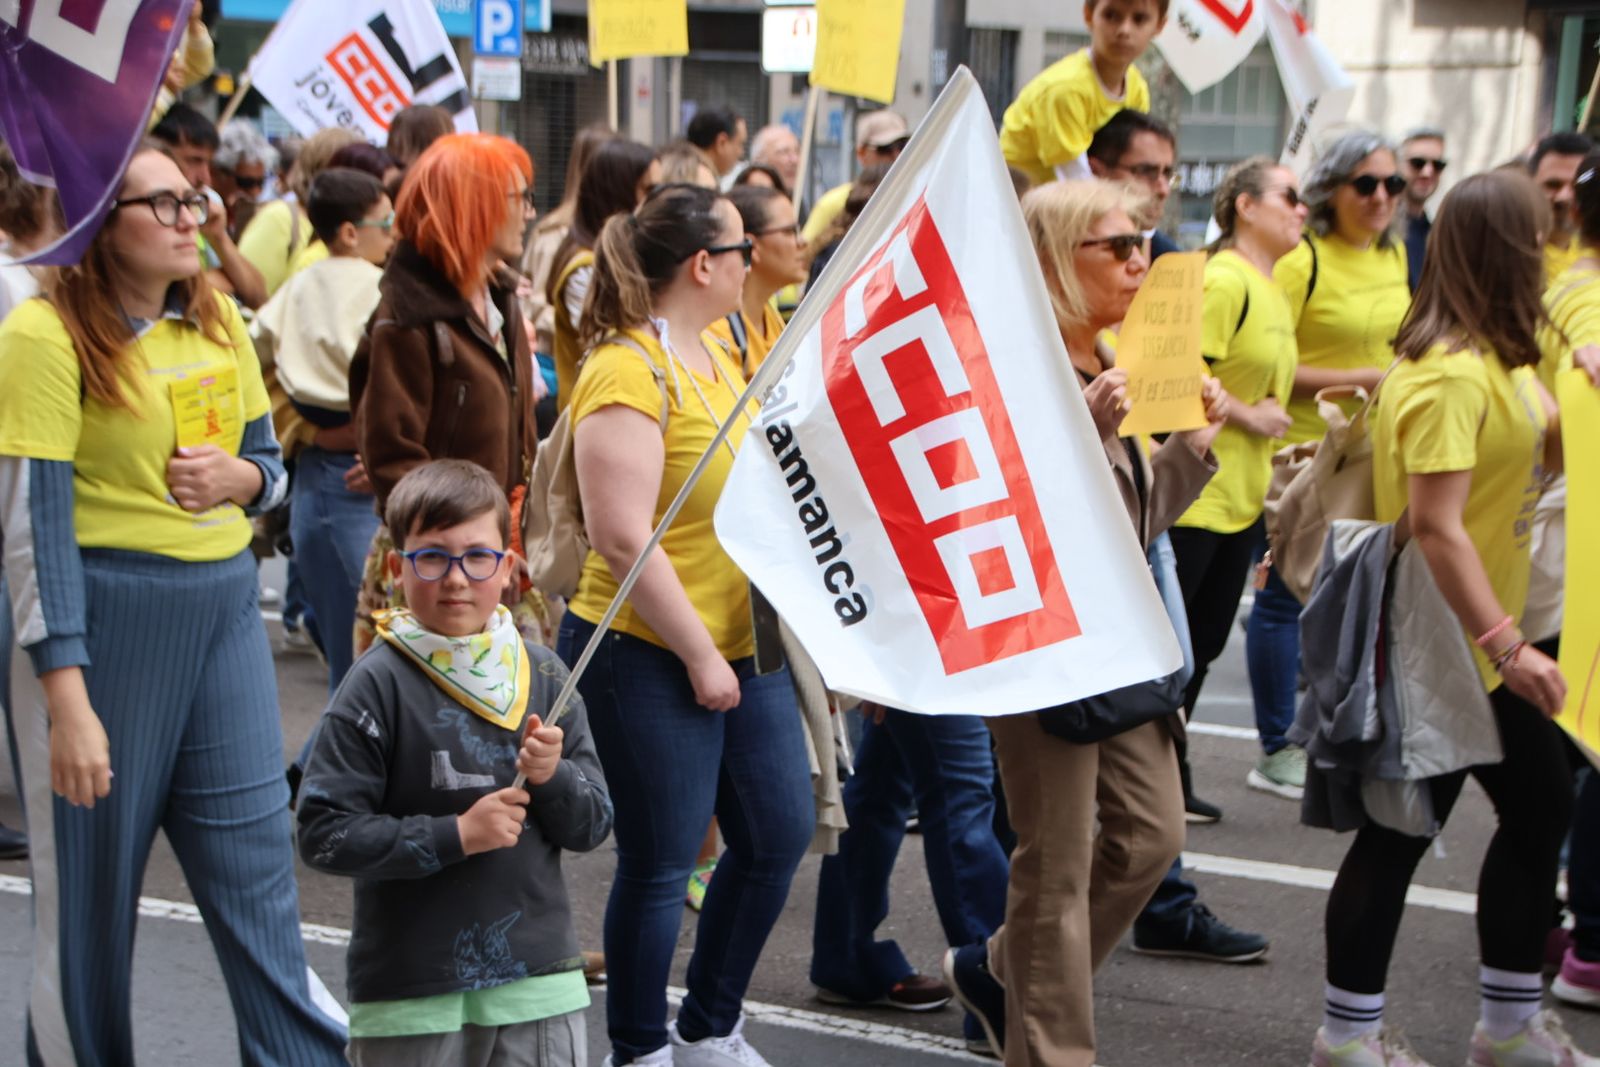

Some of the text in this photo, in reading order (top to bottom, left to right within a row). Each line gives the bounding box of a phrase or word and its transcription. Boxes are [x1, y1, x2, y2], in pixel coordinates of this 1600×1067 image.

[481, 0, 514, 51] P
[294, 66, 376, 145] jóven
[331, 38, 407, 126] CCO
[838, 220, 1053, 645] CCOO
